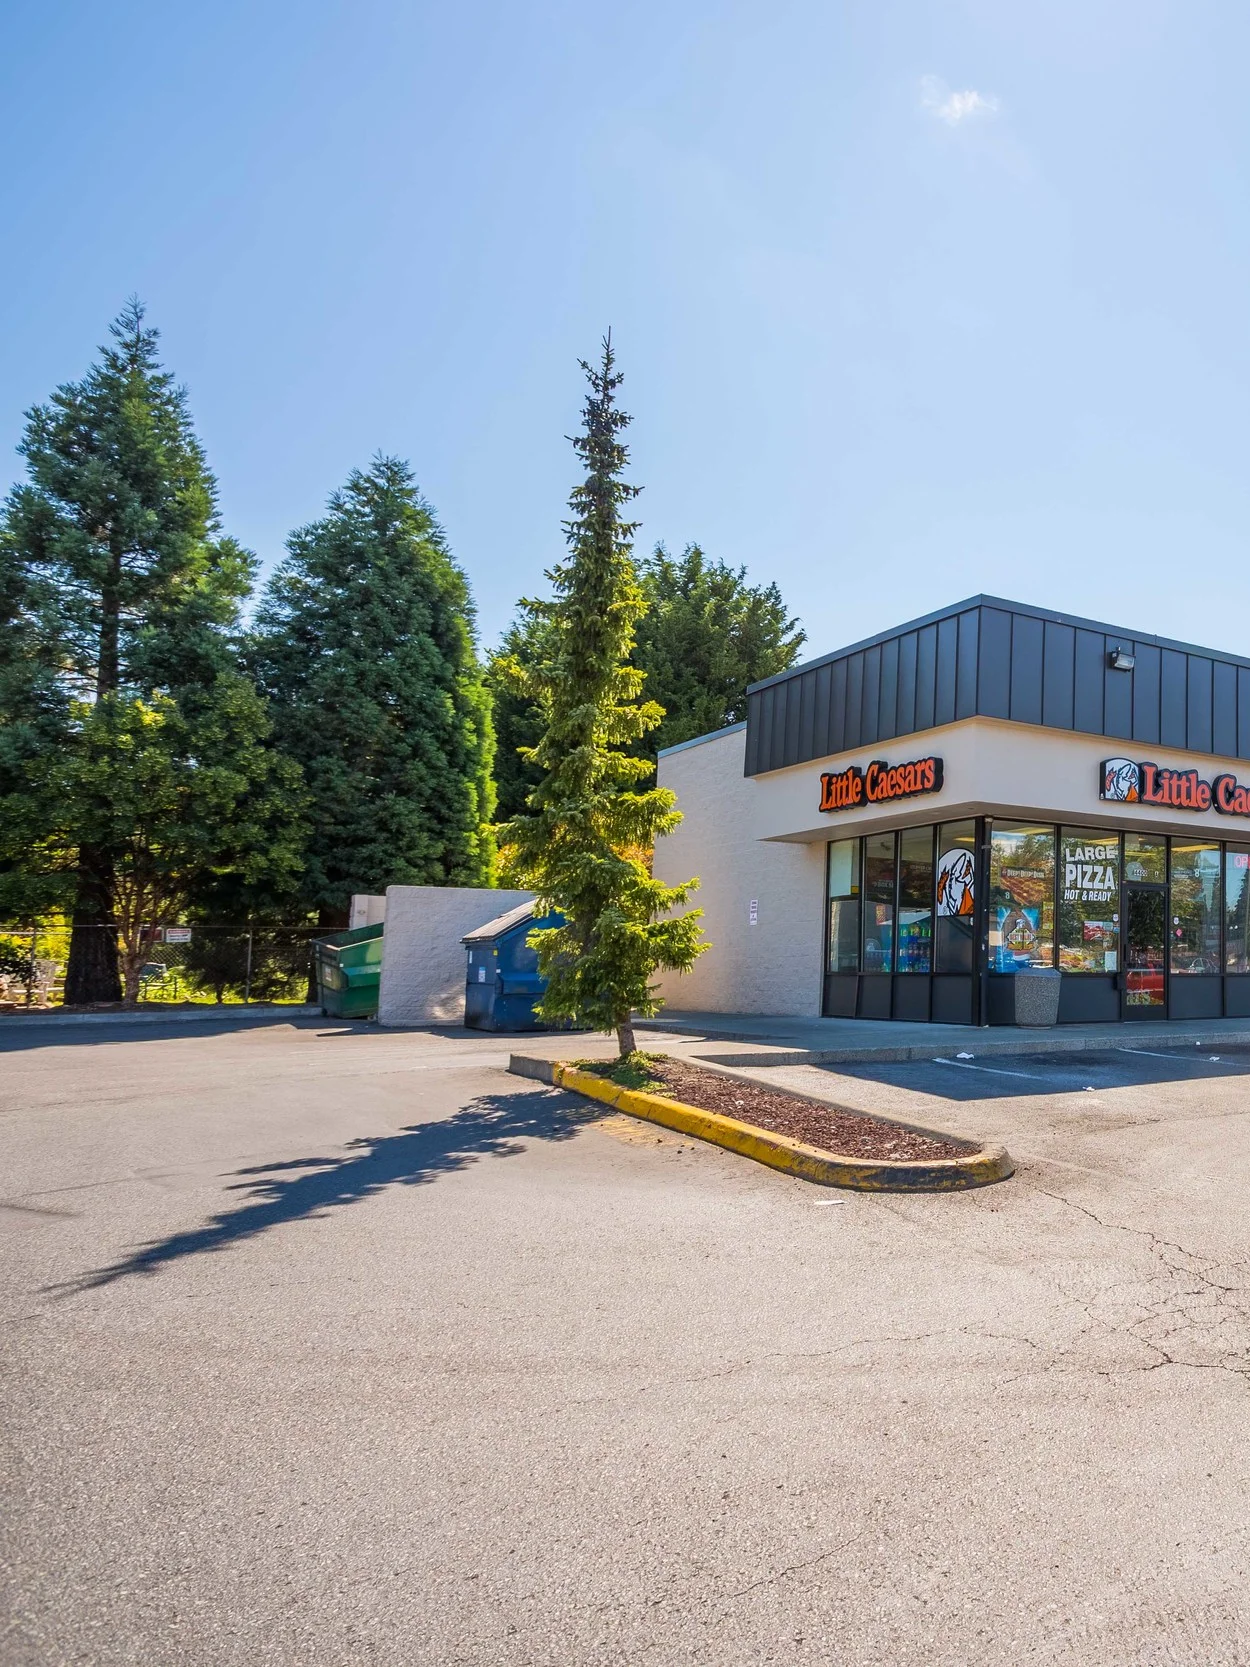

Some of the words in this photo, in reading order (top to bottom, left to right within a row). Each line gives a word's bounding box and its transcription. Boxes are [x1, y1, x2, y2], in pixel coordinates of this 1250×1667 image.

[820, 768, 862, 810] Little
[865, 758, 935, 801] Caesars
[1143, 764, 1212, 810] Little
[1065, 845, 1117, 861] LARGE
[1065, 864, 1116, 890] PIZZA
[1064, 889, 1080, 900] HOT
[1082, 890, 1088, 901] &
[1088, 890, 1112, 901] READY
